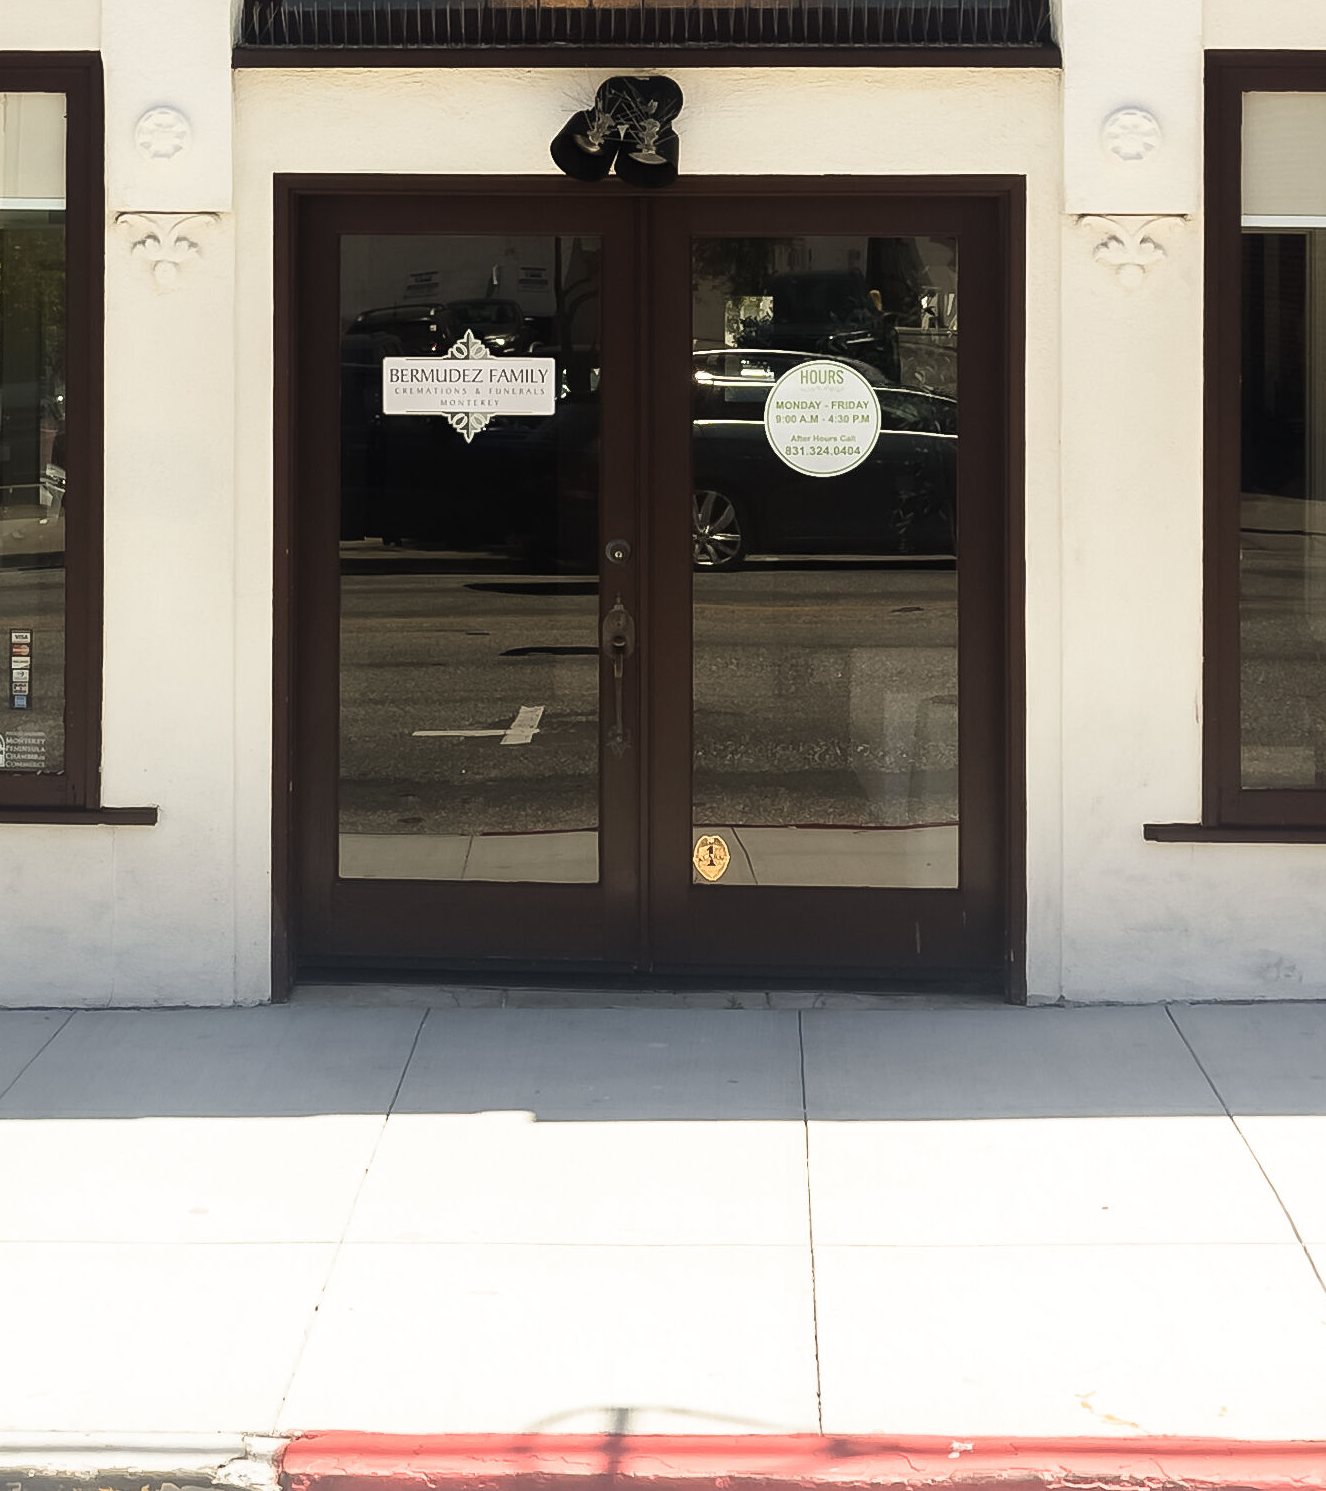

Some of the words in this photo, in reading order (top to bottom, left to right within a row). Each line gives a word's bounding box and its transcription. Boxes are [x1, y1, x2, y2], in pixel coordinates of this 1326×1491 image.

[389, 368, 484, 383] BERMUDEZ
[489, 368, 548, 384] FAMILY
[800, 369, 844, 385] HOURS
[394, 387, 468, 395] CREMATIONS
[488, 387, 546, 396] FUNERALS
[776, 401, 821, 409] MONDAY
[831, 401, 870, 409] FRIDAY
[775, 415, 797, 423] 9:00
[785, 446, 861, 456] 831.324.0404
